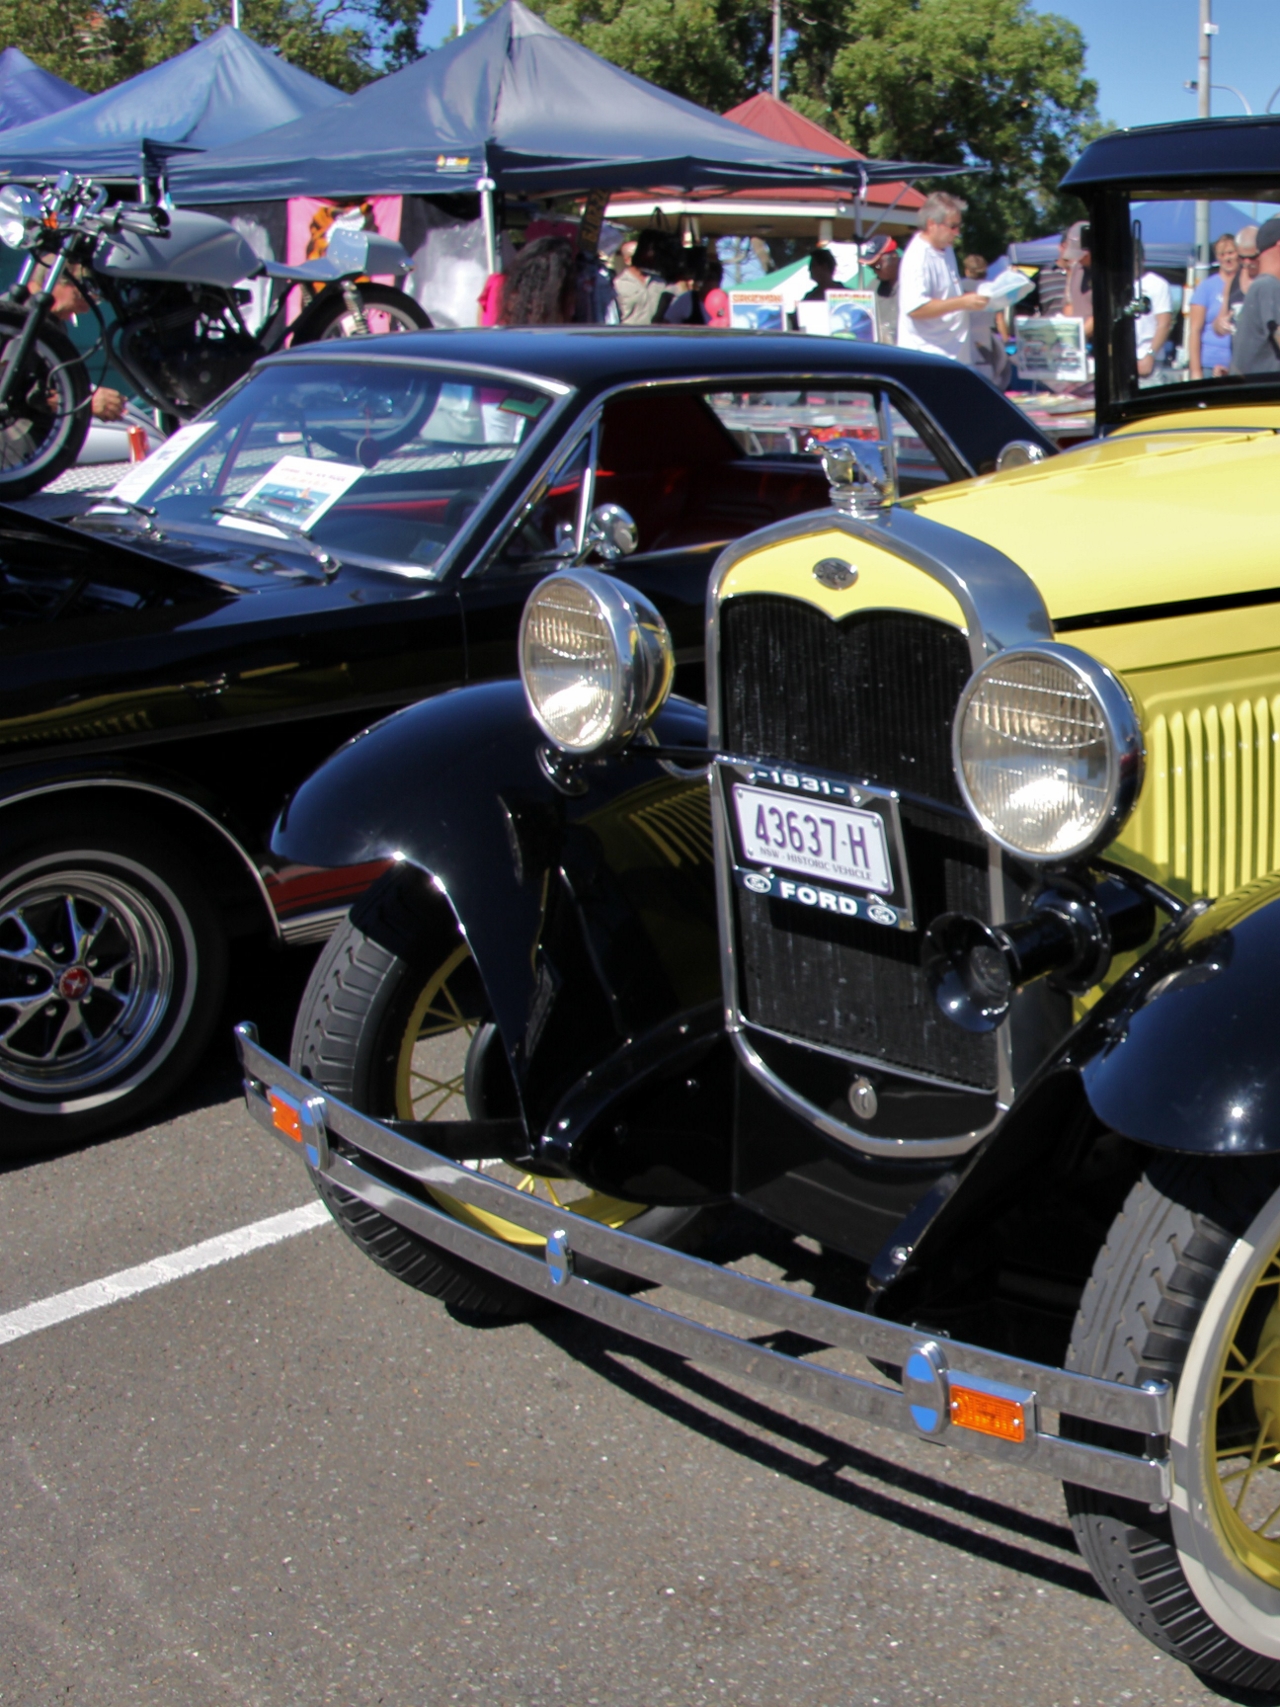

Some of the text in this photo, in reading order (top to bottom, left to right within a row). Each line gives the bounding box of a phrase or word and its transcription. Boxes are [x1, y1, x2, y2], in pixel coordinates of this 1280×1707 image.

[759, 846, 780, 859] NSW
[787, 854, 830, 871] HISTORIC
[832, 864, 873, 880] VEHICLE
[780, 881, 857, 915] FORD
